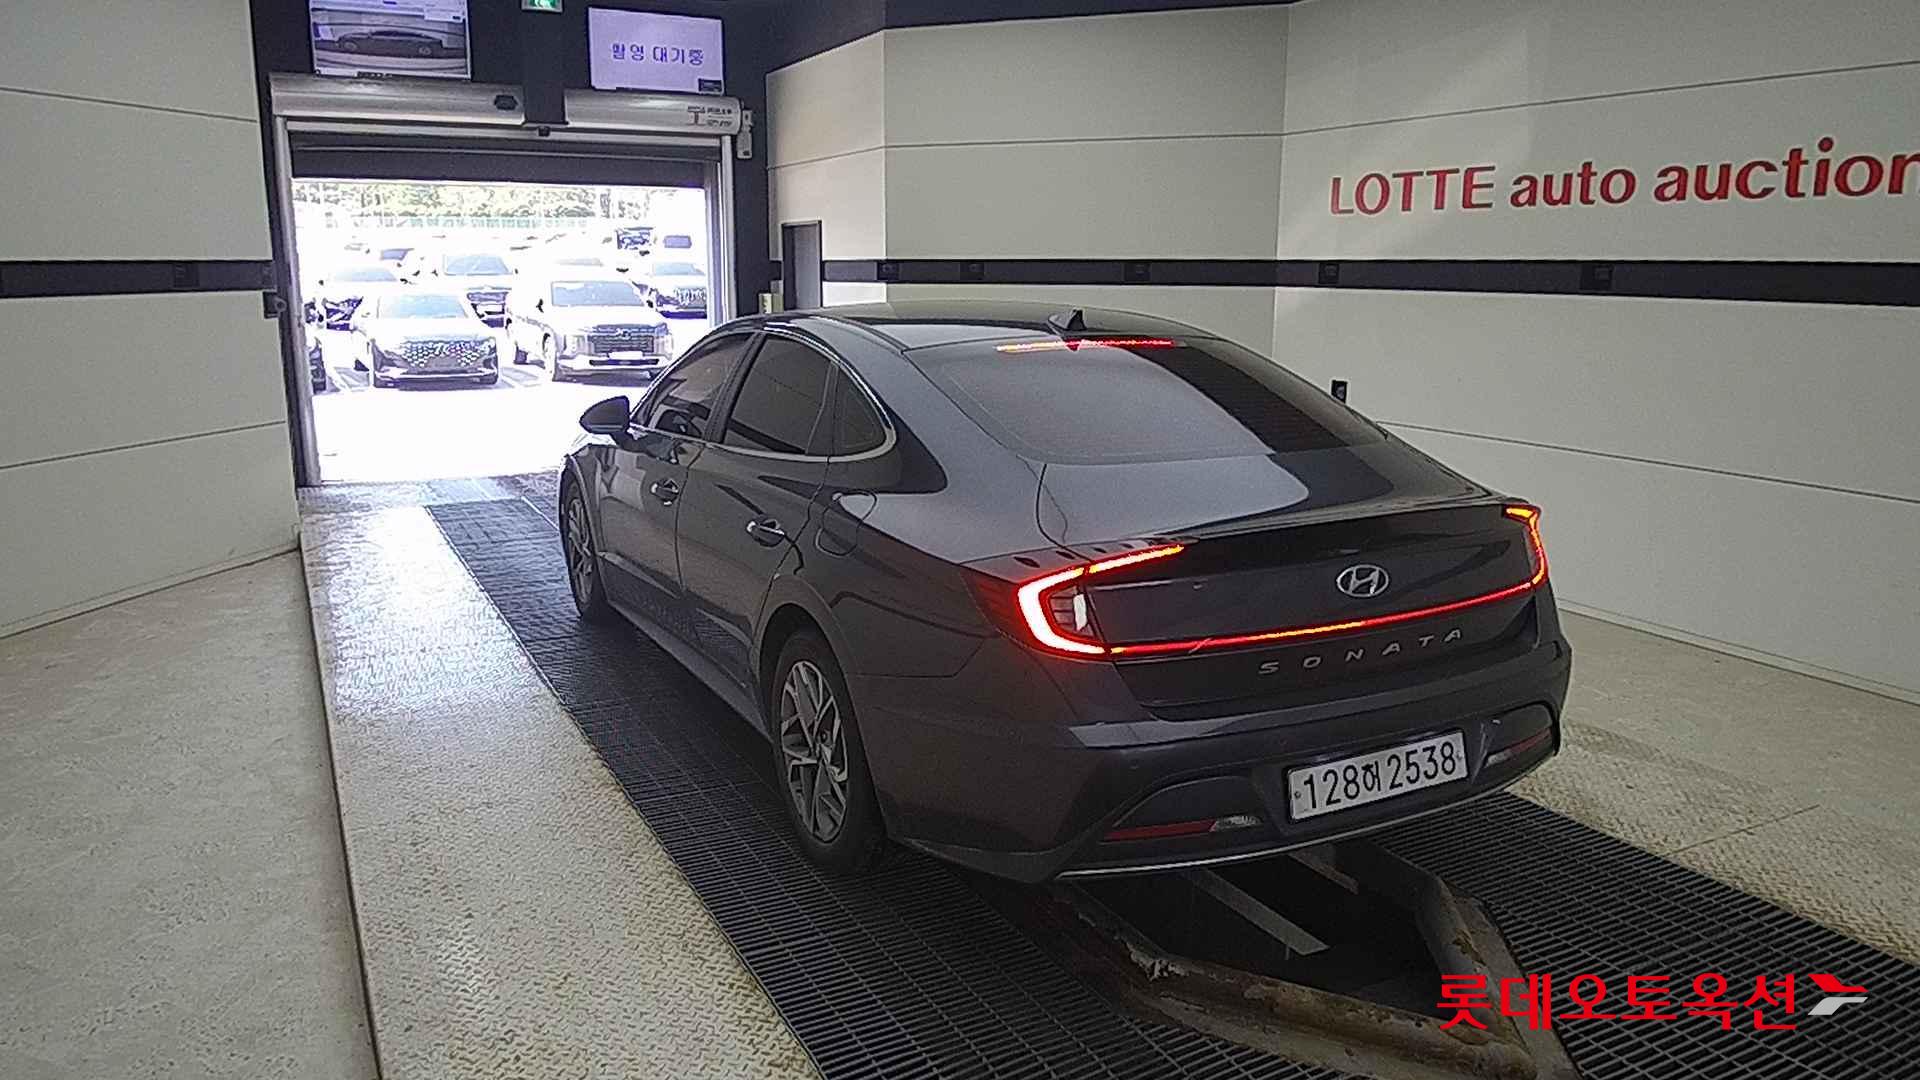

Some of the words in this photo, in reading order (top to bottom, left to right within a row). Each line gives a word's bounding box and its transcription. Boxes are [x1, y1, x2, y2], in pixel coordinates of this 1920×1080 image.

[1331, 165, 1496, 215] LOTTE
[1510, 161, 1636, 207] auto
[1259, 629, 1462, 675] SONATA
